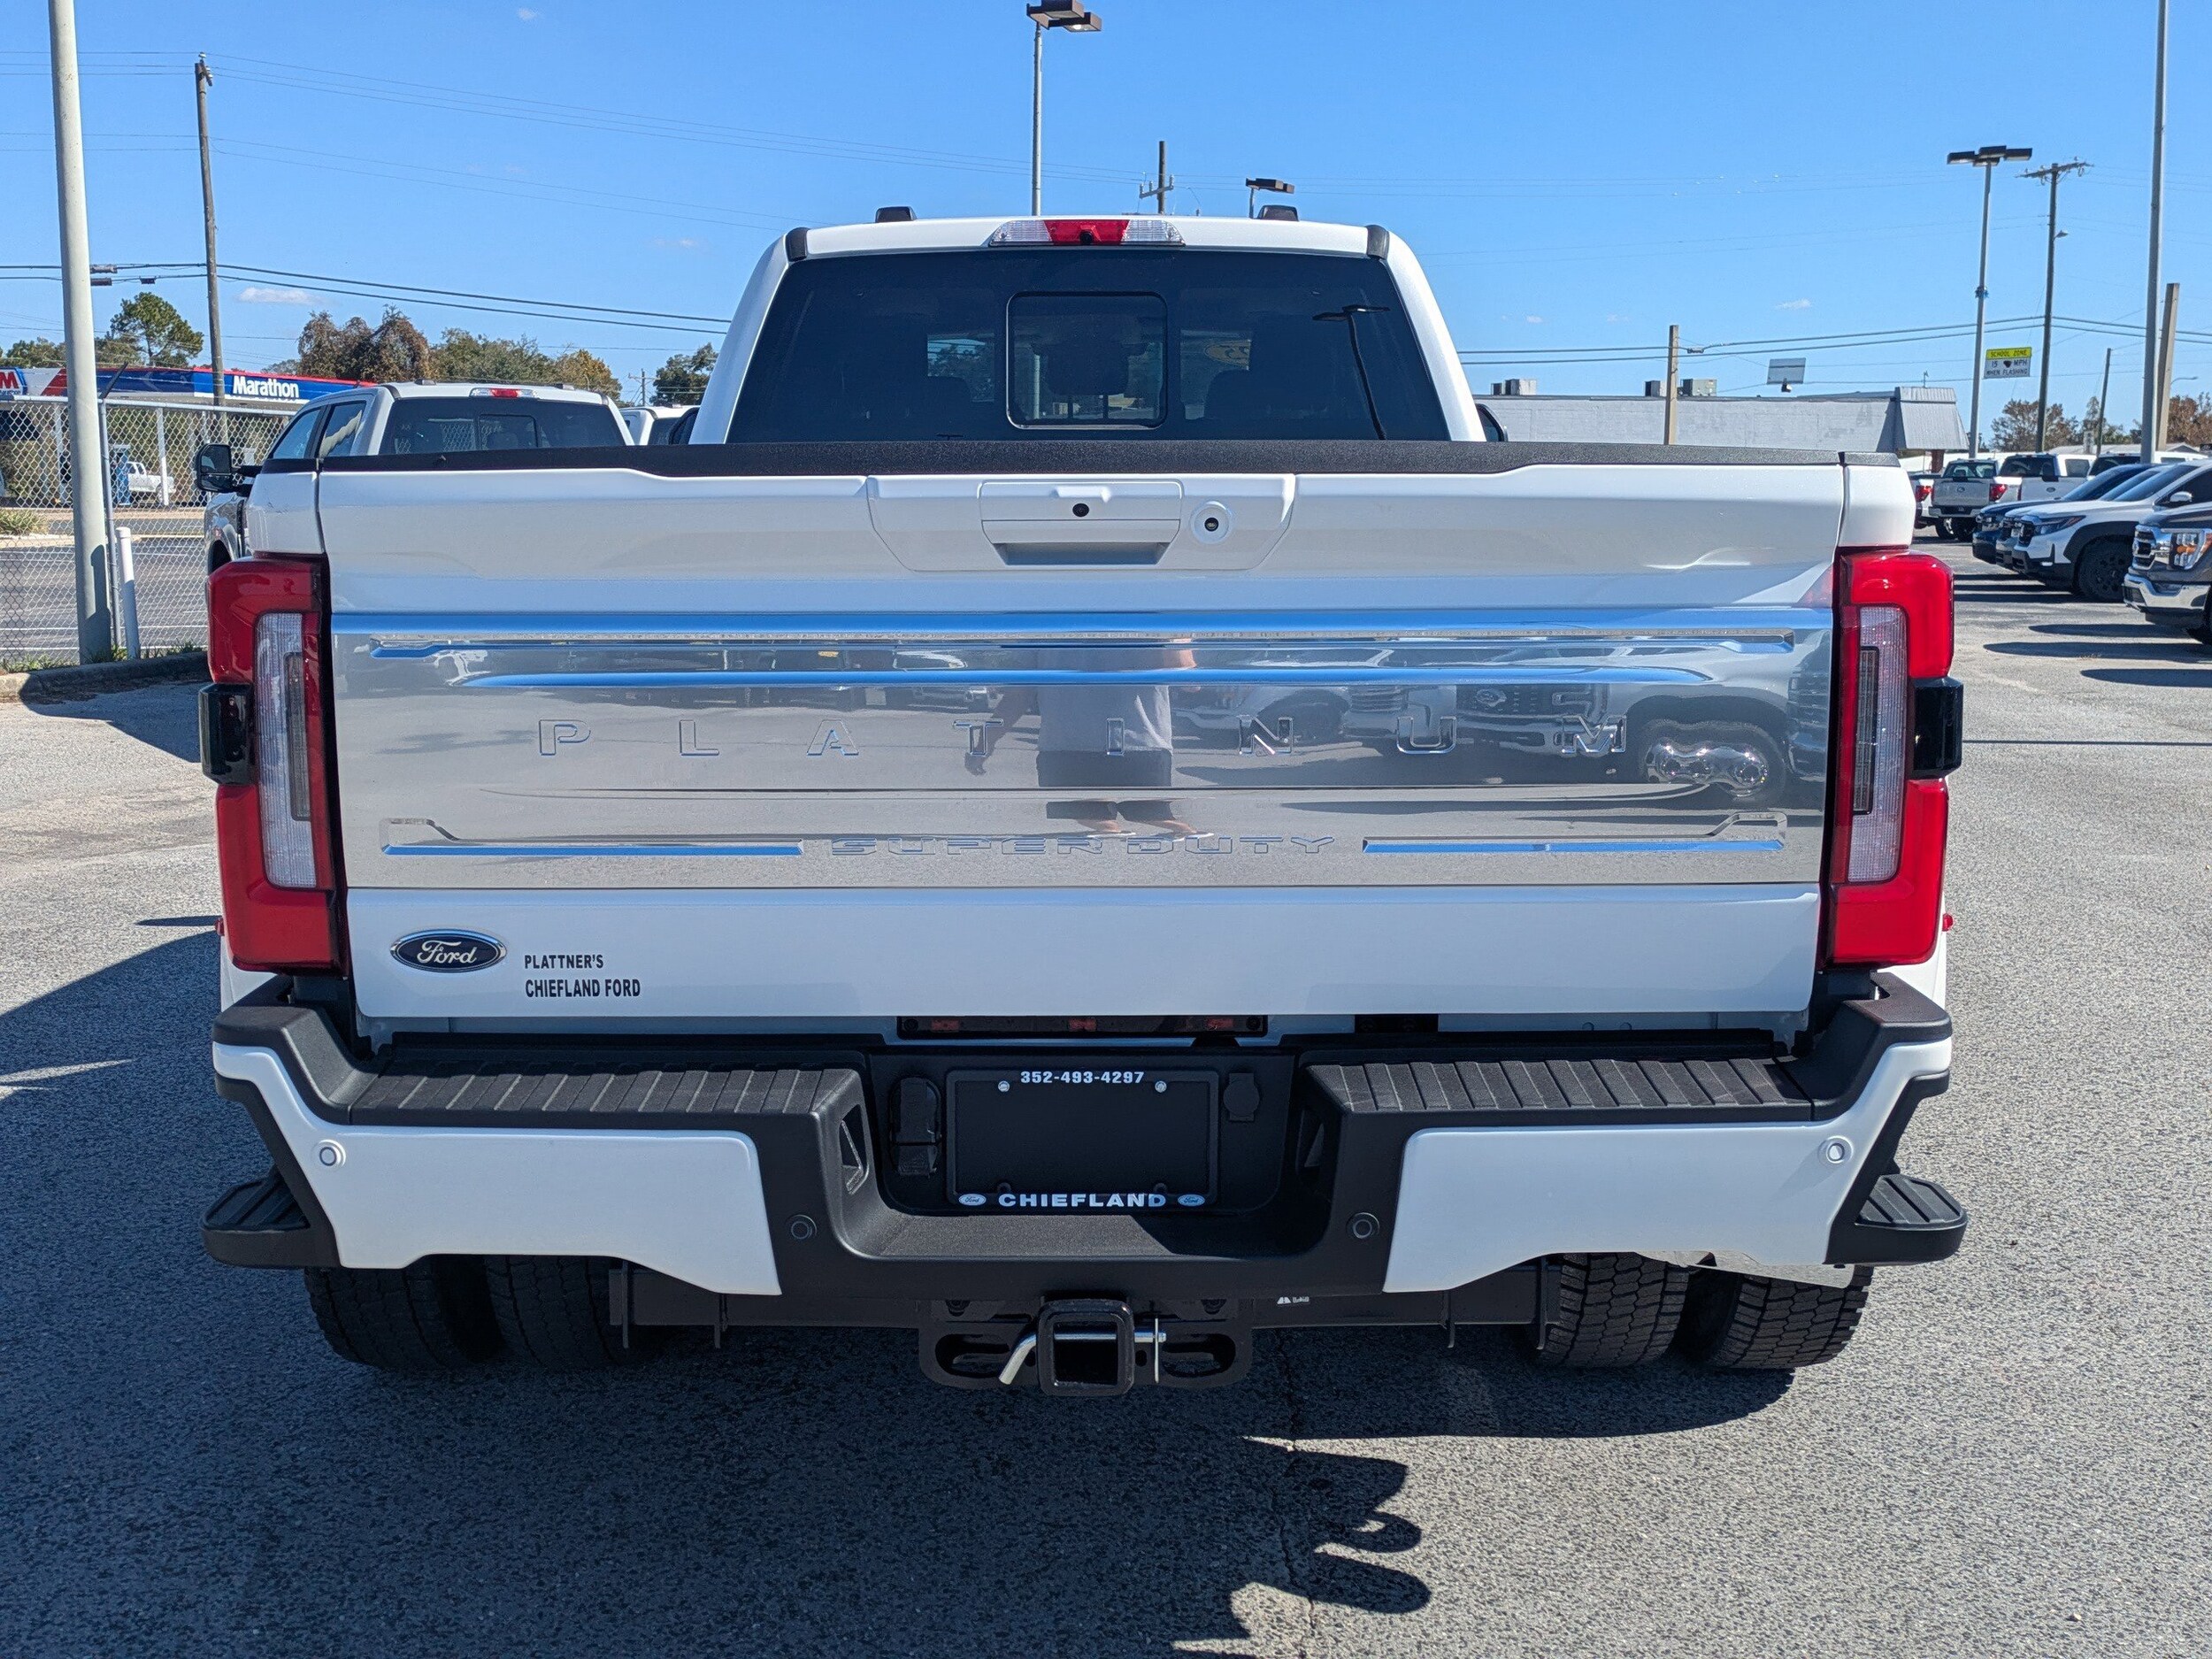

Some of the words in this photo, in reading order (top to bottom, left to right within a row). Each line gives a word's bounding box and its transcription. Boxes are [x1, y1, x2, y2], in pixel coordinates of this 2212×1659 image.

[232, 375, 300, 398] Marathon
[538, 717, 1627, 756] PLATINUM
[831, 836, 1103, 856] SUPER
[1126, 834, 1335, 856] DUTY
[417, 940, 477, 964] Ford
[525, 954, 604, 969] PLATTNER'S
[525, 979, 601, 998] CHIEFLAND
[604, 979, 641, 998] FORD
[1020, 1071, 1145, 1084] 352-493-4297
[998, 1193, 1166, 1207] CHIEFLAND
